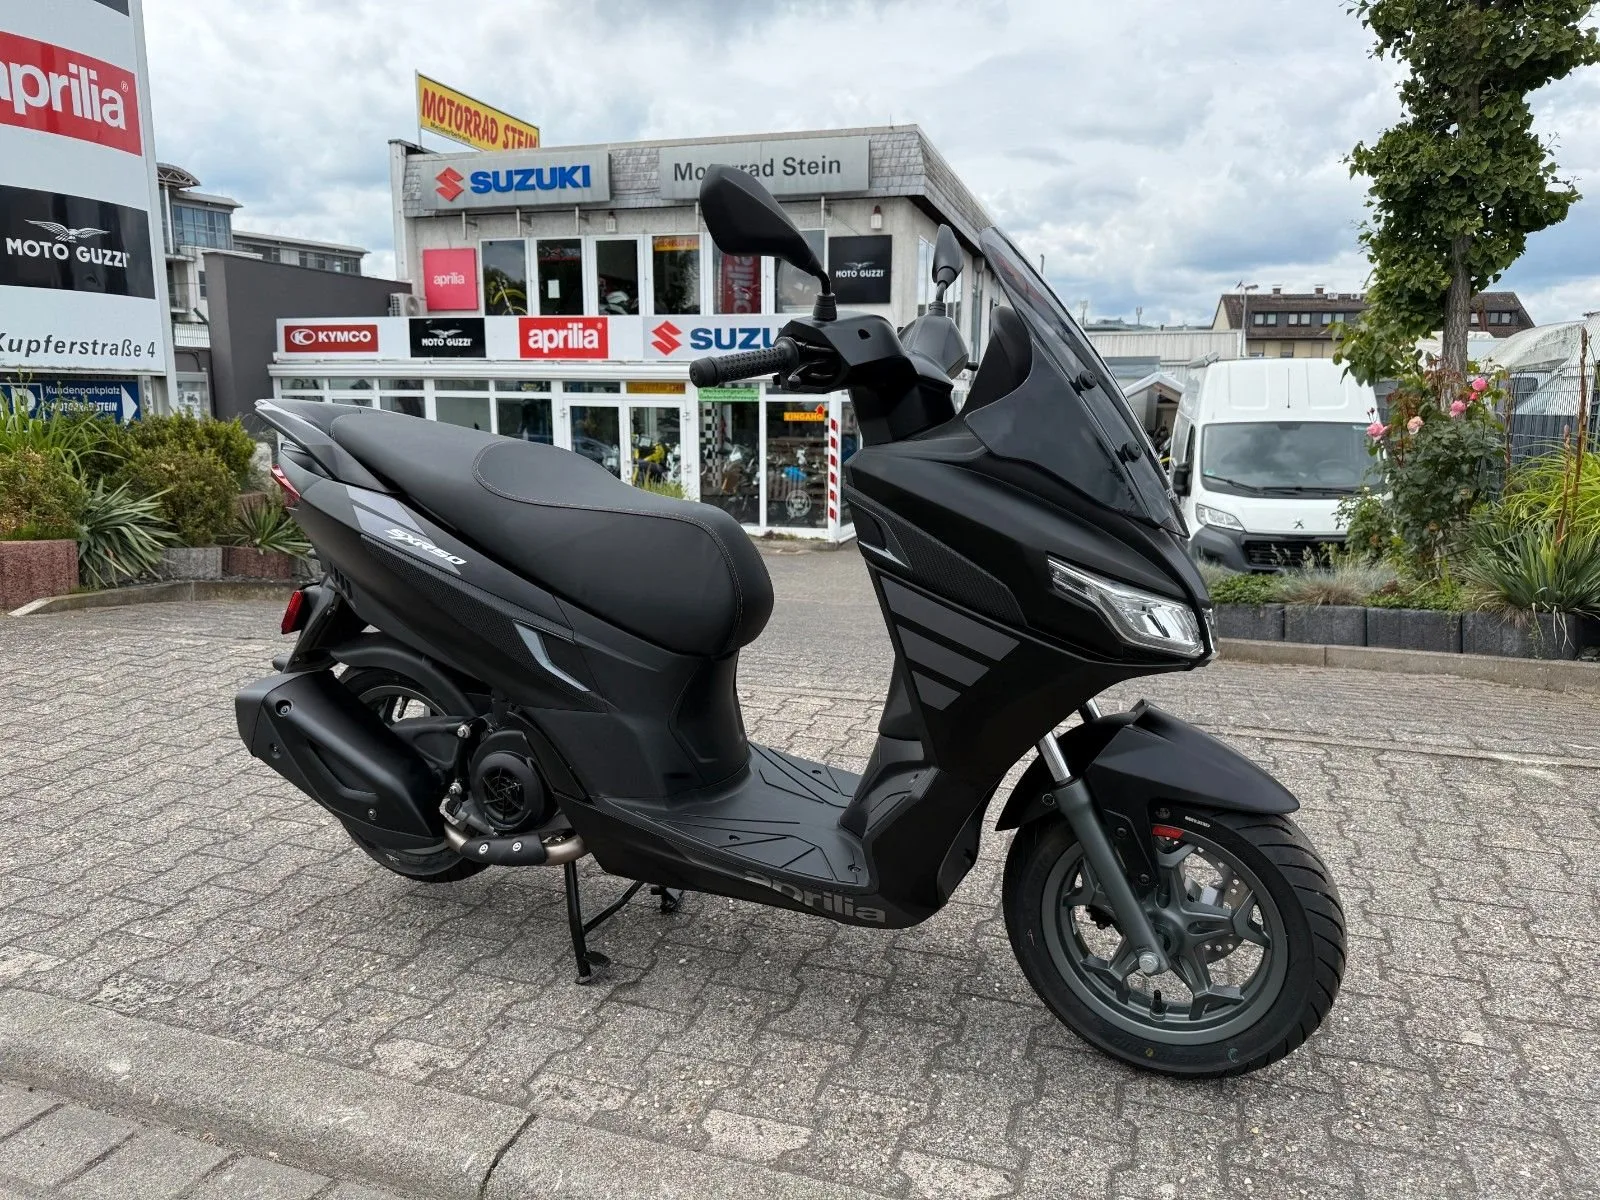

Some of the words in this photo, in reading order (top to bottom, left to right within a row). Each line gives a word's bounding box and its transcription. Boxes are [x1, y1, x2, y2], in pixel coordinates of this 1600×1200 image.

[422, 88, 499, 146] MOTORRAD
[502, 123, 537, 150] STEIN
[782, 155, 841, 177] Stein
[470, 164, 591, 194] SUZUKI
[6, 237, 69, 260] MOTO
[76, 246, 128, 268] GUZZI
[433, 272, 465, 288] aprilia
[836, 270, 858, 278] MOTO
[860, 269, 884, 278] GUZZI
[318, 330, 372, 343] KYMCO
[421, 338, 444, 347] MOTO
[446, 338, 471, 347] GUZZI
[528, 322, 599, 353] aprilia
[690, 327, 783, 350] SUZU
[147, 341, 156, 358] 4
